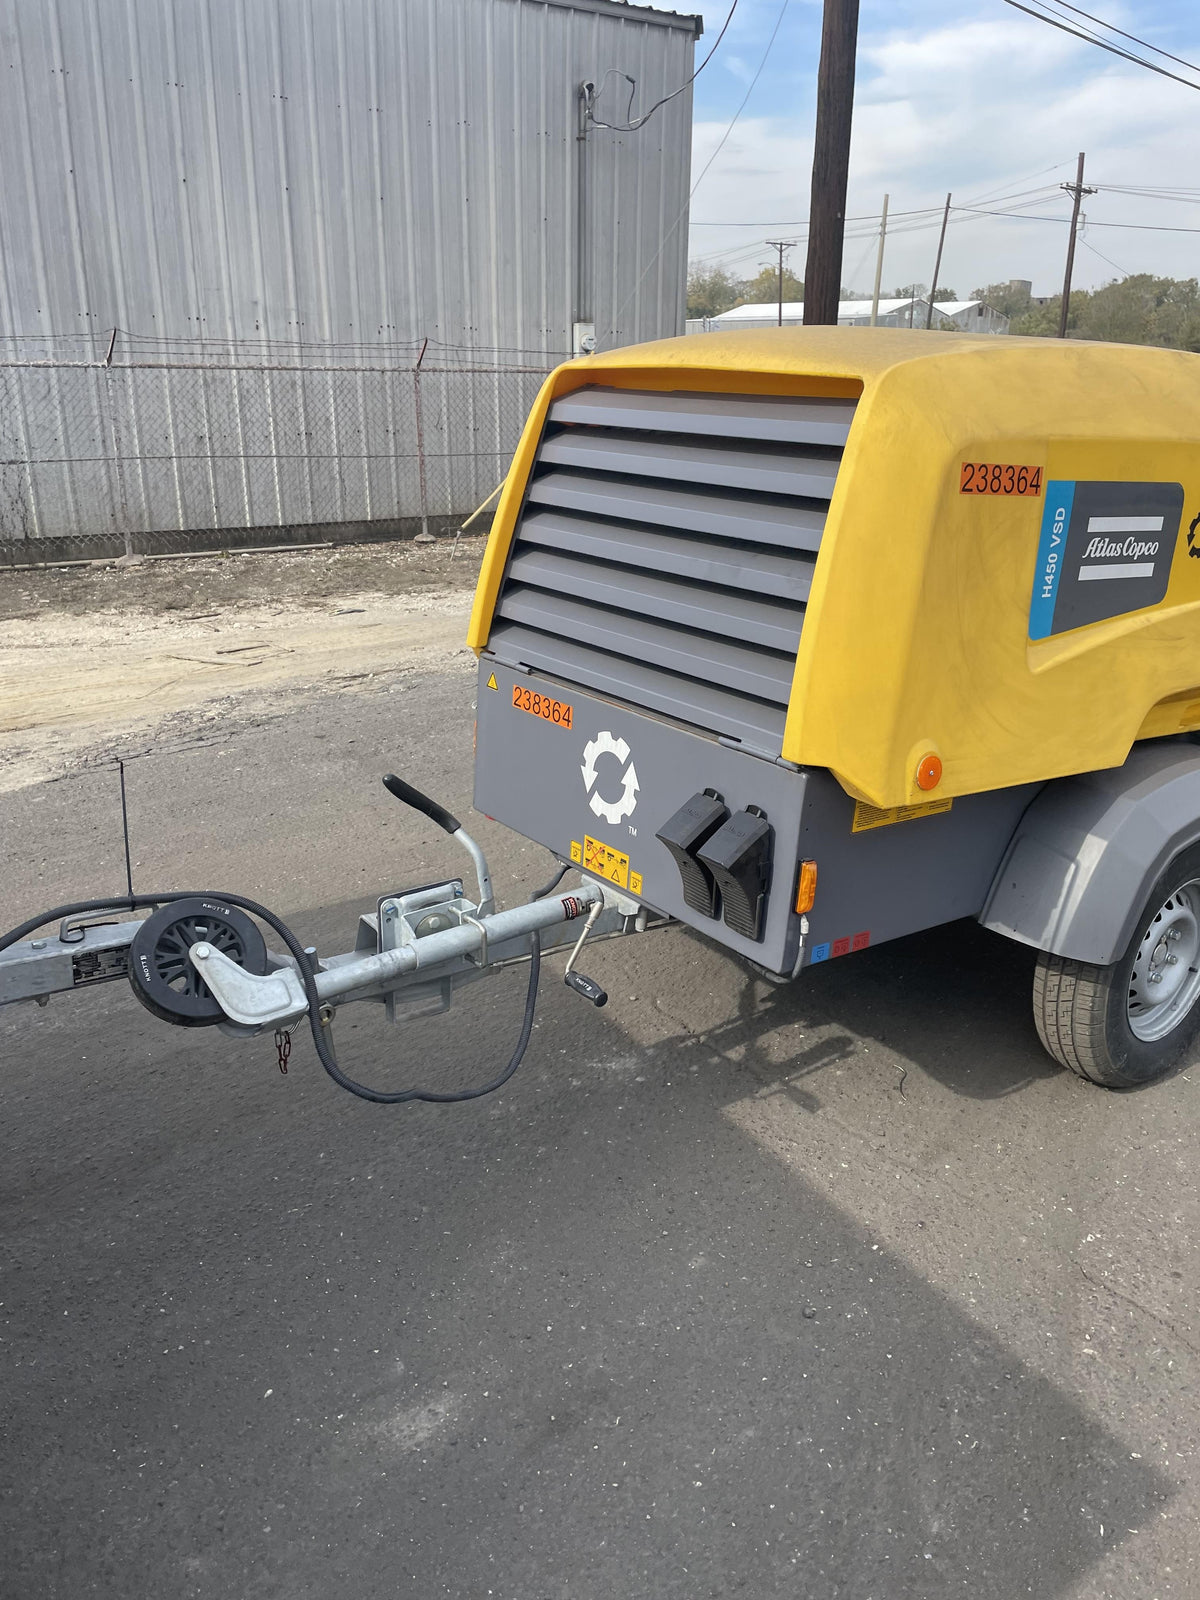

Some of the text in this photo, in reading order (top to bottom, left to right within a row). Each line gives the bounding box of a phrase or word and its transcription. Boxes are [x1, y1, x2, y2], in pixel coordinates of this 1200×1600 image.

[961, 463, 1041, 494] 238364
[1041, 507, 1066, 598] H450 VSD
[1082, 536, 1159, 560] Atlas Copco
[513, 686, 572, 728] 238364
[628, 825, 638, 837] TM
[141, 961, 151, 982] KNOTT
